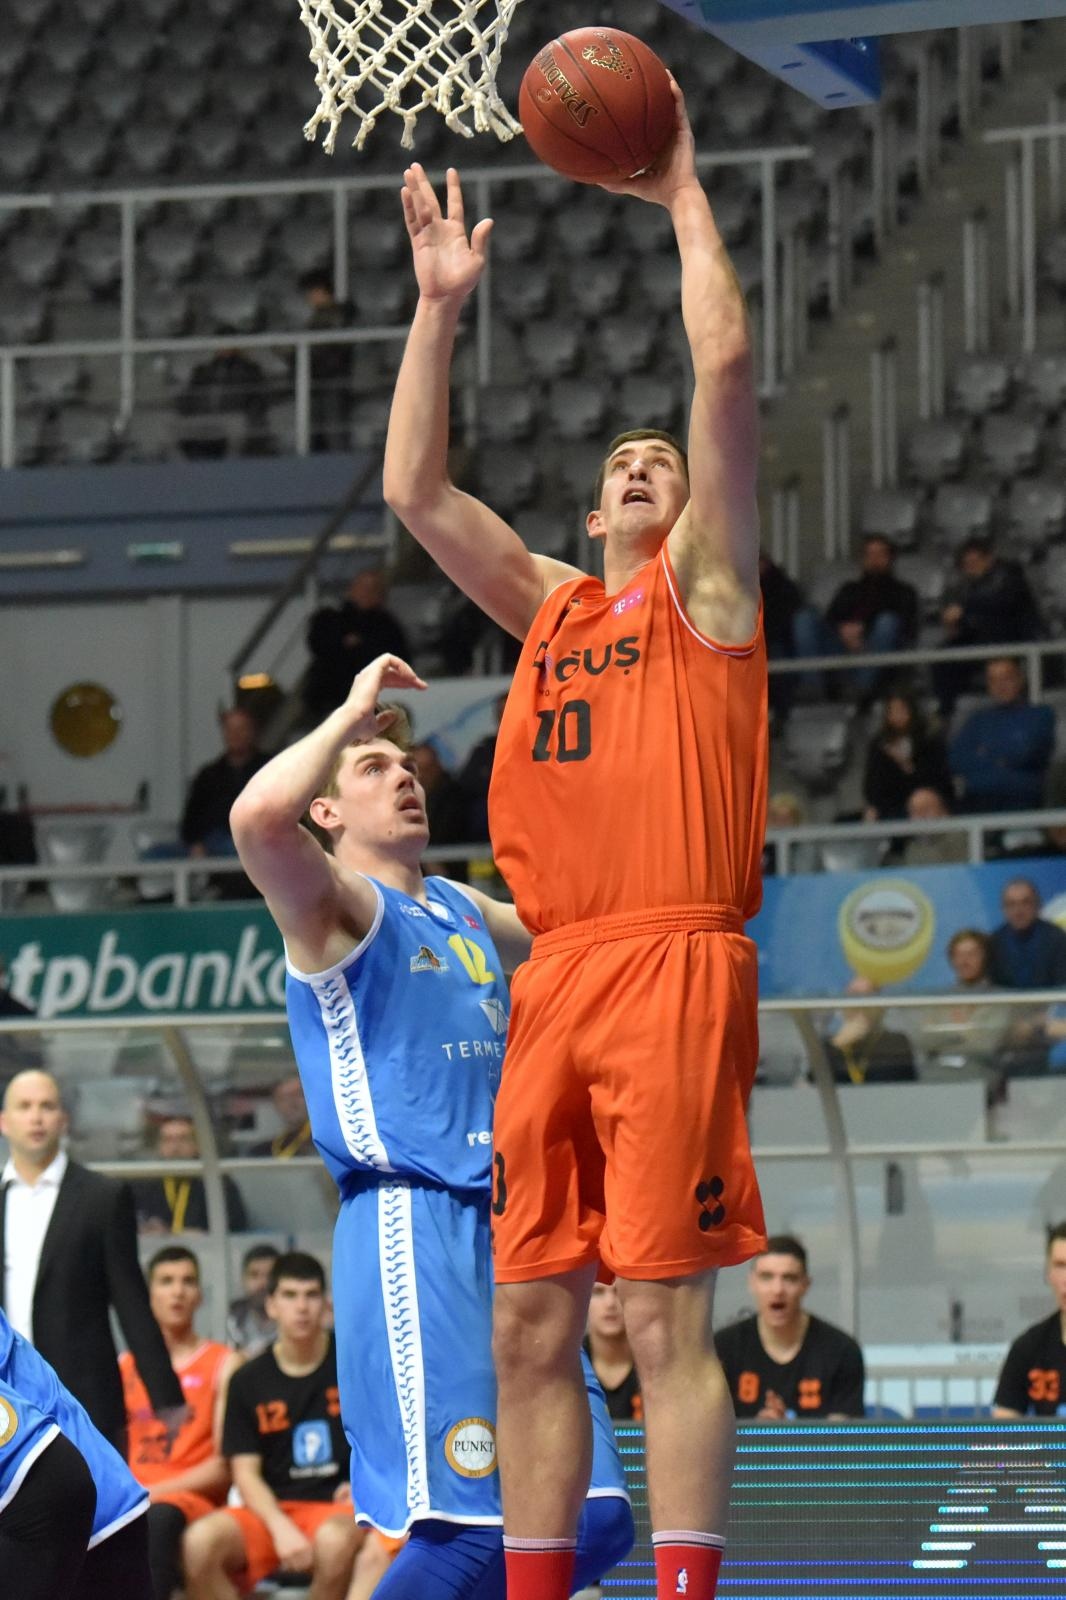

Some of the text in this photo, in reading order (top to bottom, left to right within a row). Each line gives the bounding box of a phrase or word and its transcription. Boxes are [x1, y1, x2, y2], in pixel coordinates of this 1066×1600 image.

[441, 1039, 507, 1061] TERME
[466, 1130, 494, 1147] re
[454, 1440, 495, 1454] PUNKT
